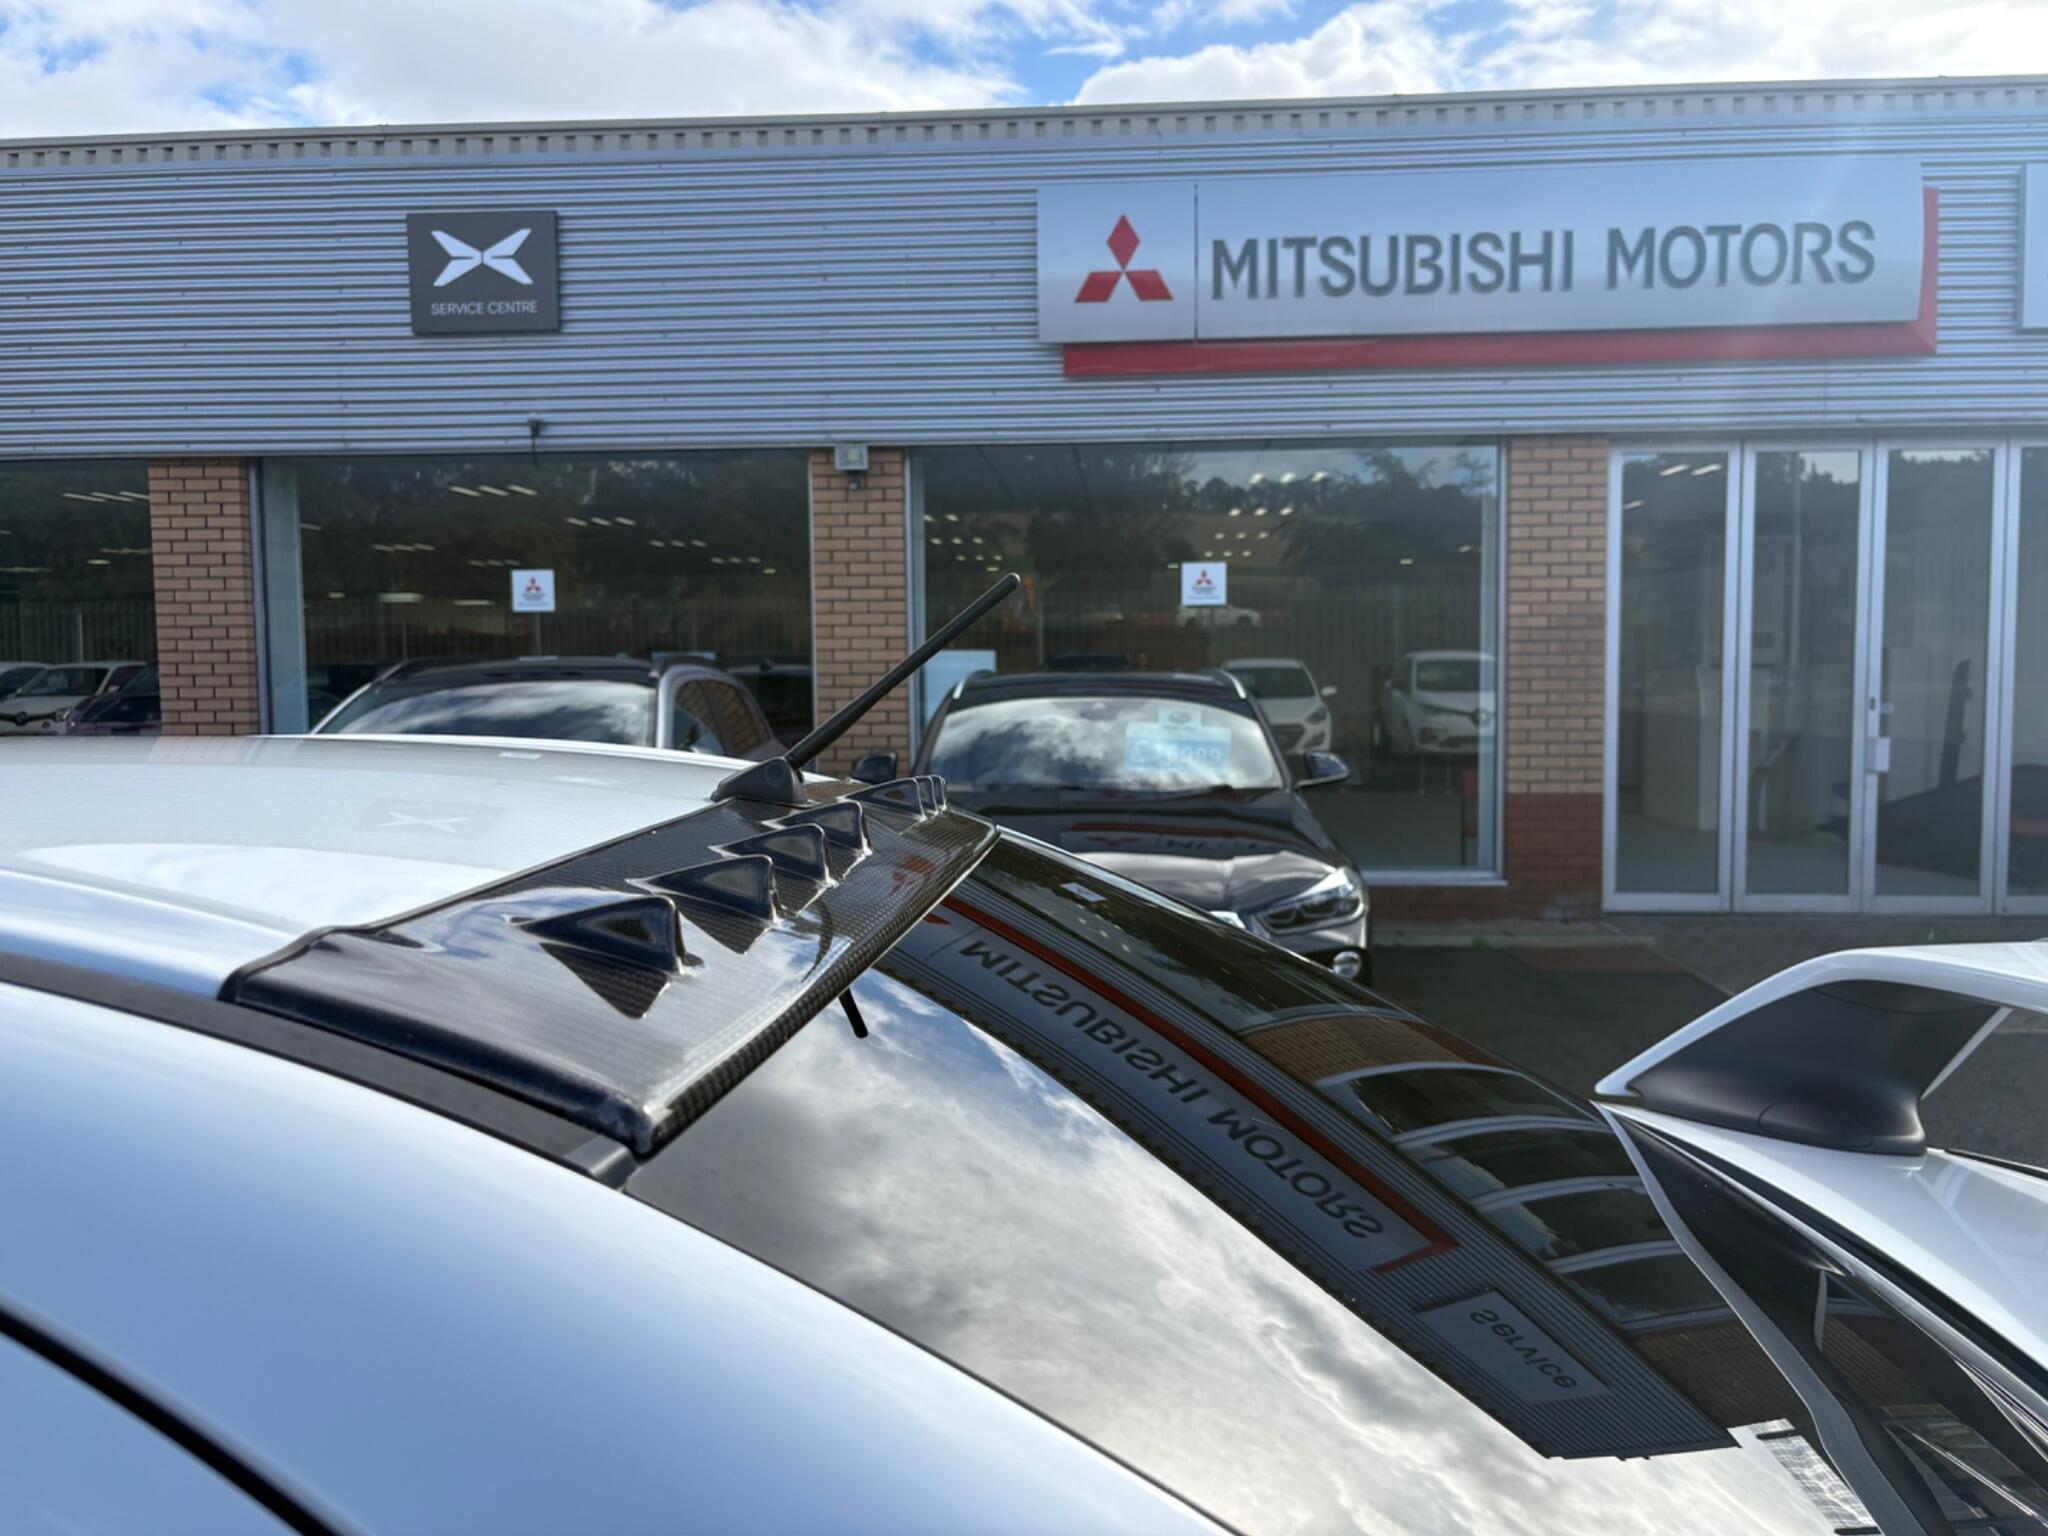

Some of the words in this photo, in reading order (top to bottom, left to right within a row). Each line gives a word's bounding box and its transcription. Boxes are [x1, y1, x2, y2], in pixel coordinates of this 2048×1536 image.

[1211, 231, 1574, 300] MITSUBISHI
[1605, 220, 1876, 290] MOTORS
[430, 302, 485, 316] SERVICE
[487, 300, 539, 315] CENTRE
